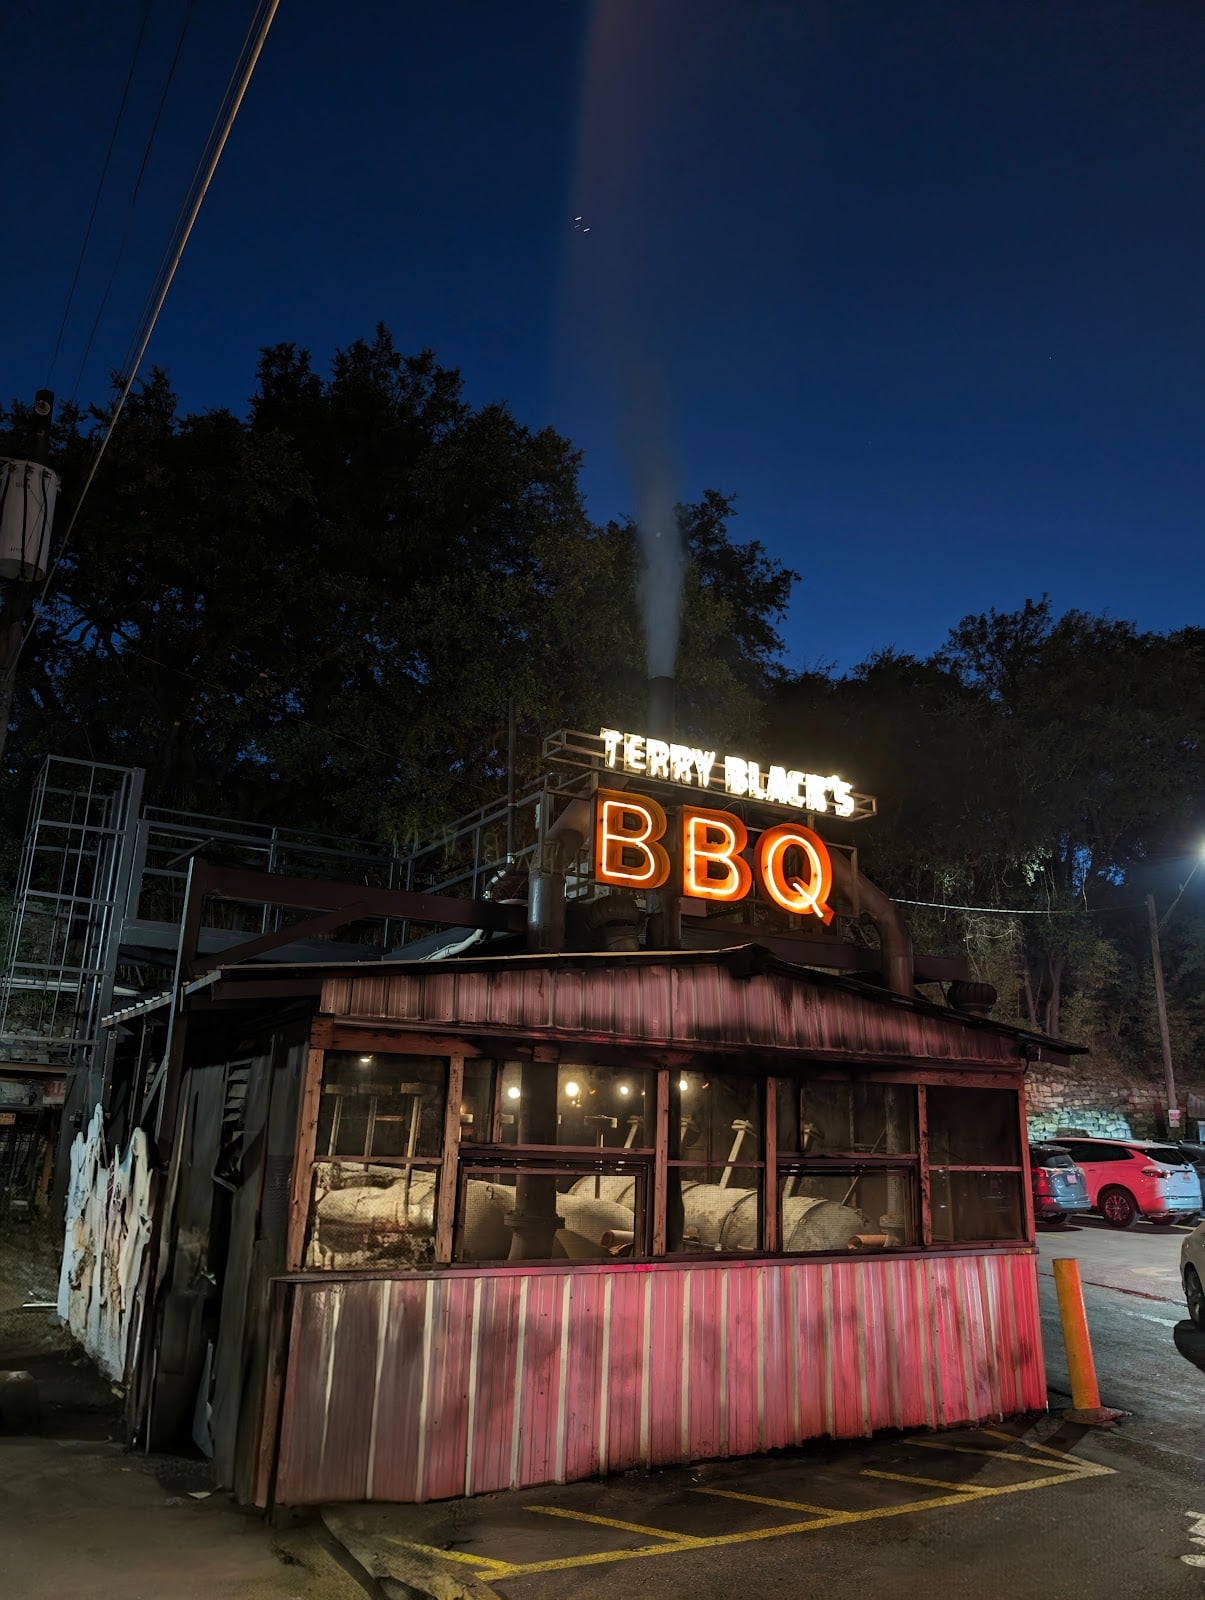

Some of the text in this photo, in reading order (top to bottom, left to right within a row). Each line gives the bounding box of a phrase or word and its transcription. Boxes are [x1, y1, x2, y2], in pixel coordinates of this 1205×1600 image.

[600, 727, 855, 817] TERRY BLACK'S
[595, 788, 835, 926] BBQ
